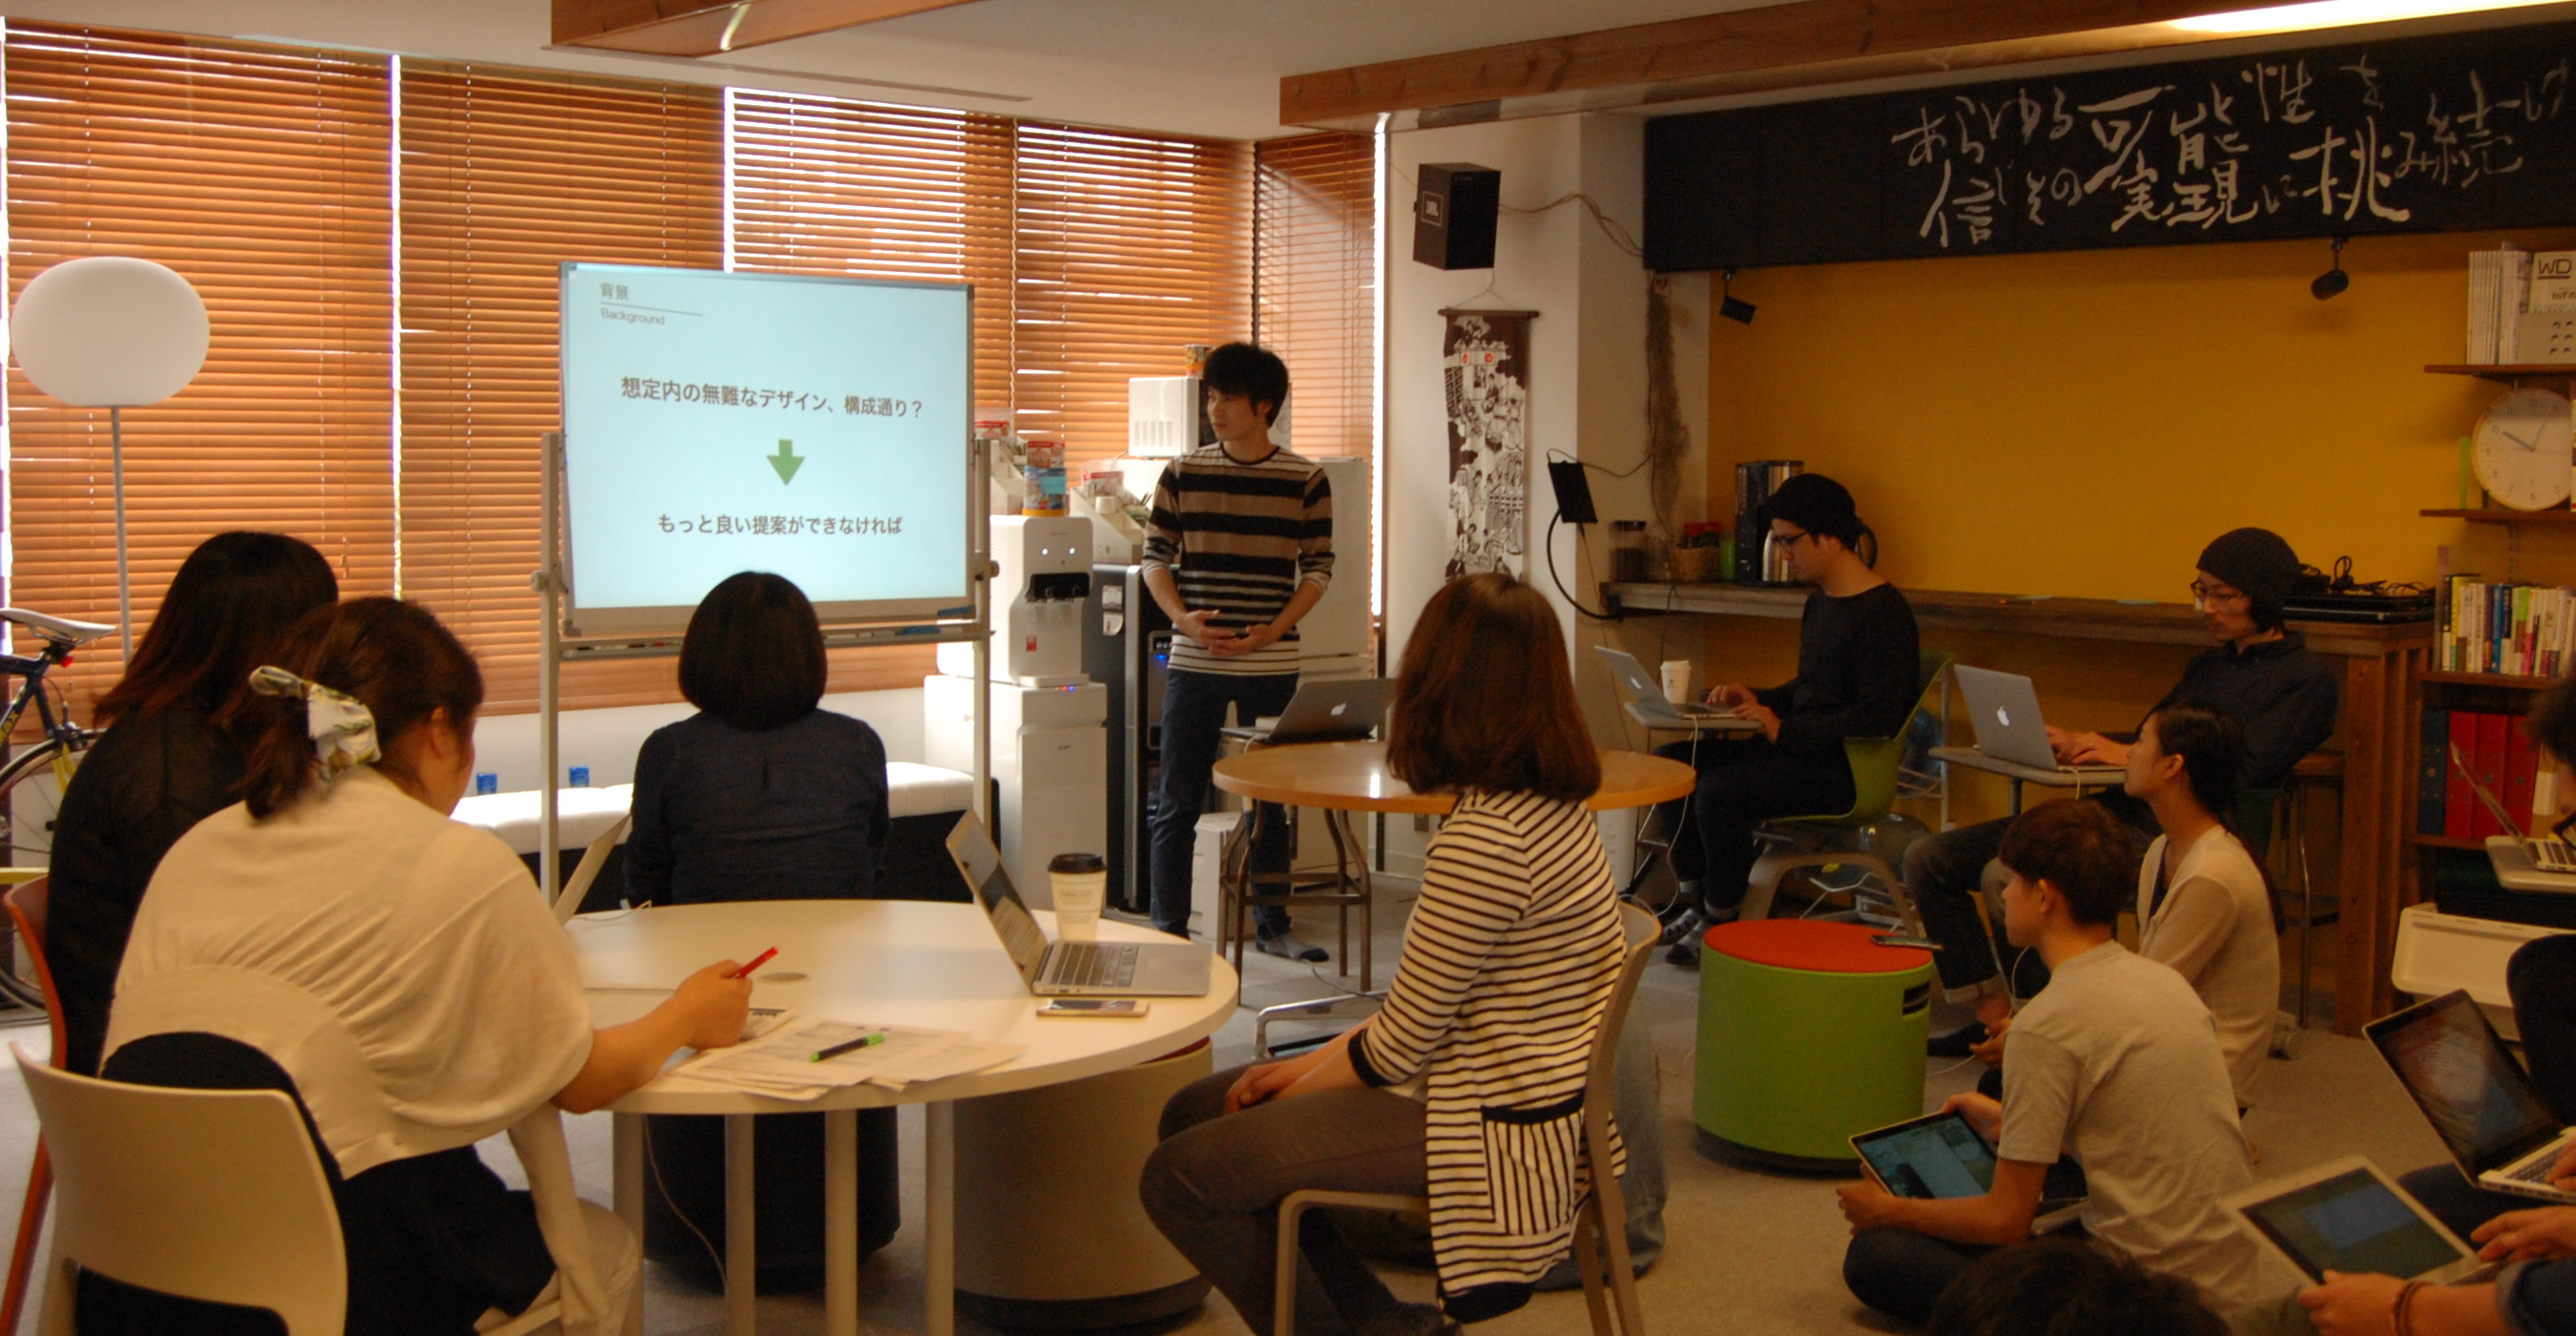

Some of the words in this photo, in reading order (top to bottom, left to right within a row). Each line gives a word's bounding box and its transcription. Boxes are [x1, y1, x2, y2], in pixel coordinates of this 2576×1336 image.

[2538, 259, 2572, 275] WD
[600, 283, 630, 302] 背景
[601, 307, 666, 325] Background
[657, 513, 904, 535] もっと良い提案ができなければ
